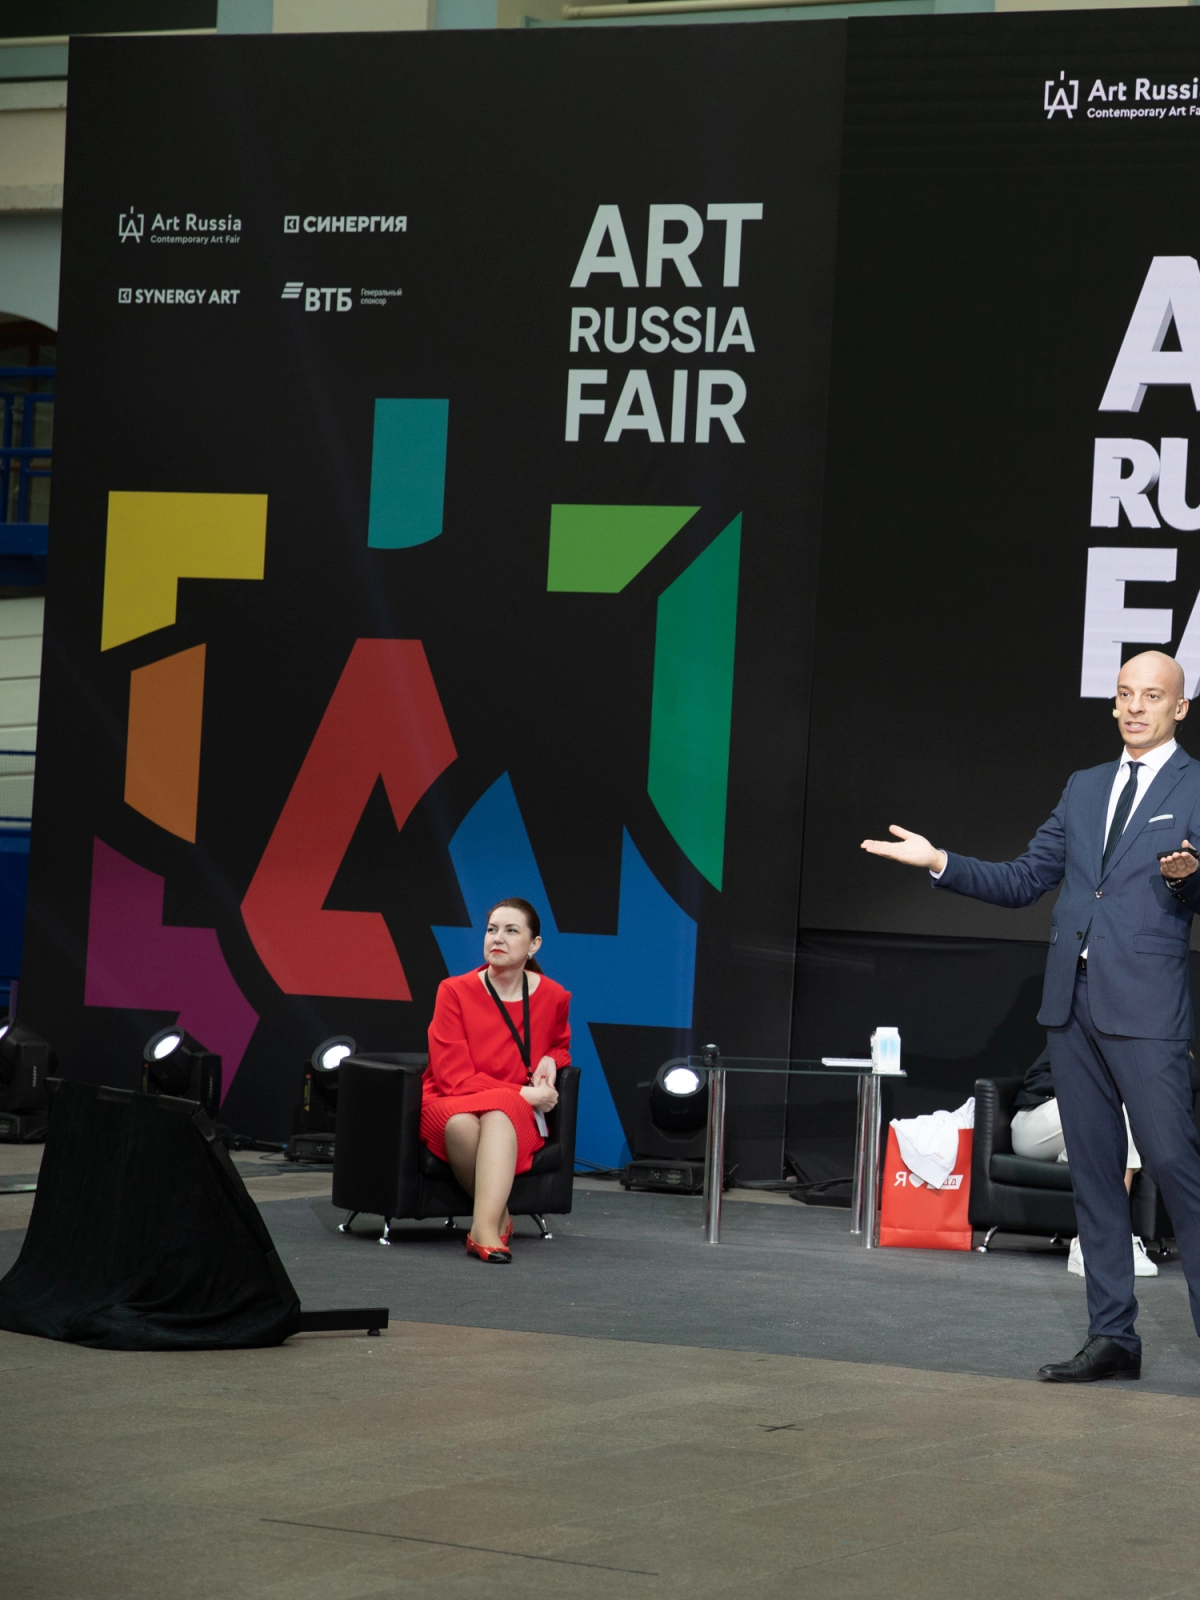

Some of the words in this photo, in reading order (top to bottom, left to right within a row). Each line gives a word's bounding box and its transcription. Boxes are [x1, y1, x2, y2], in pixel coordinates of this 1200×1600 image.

[1087, 79, 1127, 101] Art
[1086, 107, 1167, 119] Contemporary
[1168, 106, 1187, 116] Art
[151, 213, 180, 231] Art
[186, 213, 242, 231] Russia
[303, 216, 408, 232] СИНЕРГИЯ
[150, 235, 209, 245] Contemporary
[210, 235, 224, 244] Art
[225, 234, 241, 244] Fair
[569, 203, 764, 288] ART
[135, 289, 206, 304] SYNERGY
[208, 289, 241, 304] ART
[305, 287, 353, 312] ВТБ
[360, 288, 403, 297] Генеральный
[569, 306, 756, 353] RUSSIA
[565, 369, 747, 443] FAIR
[894, 1171, 906, 1187] Я
